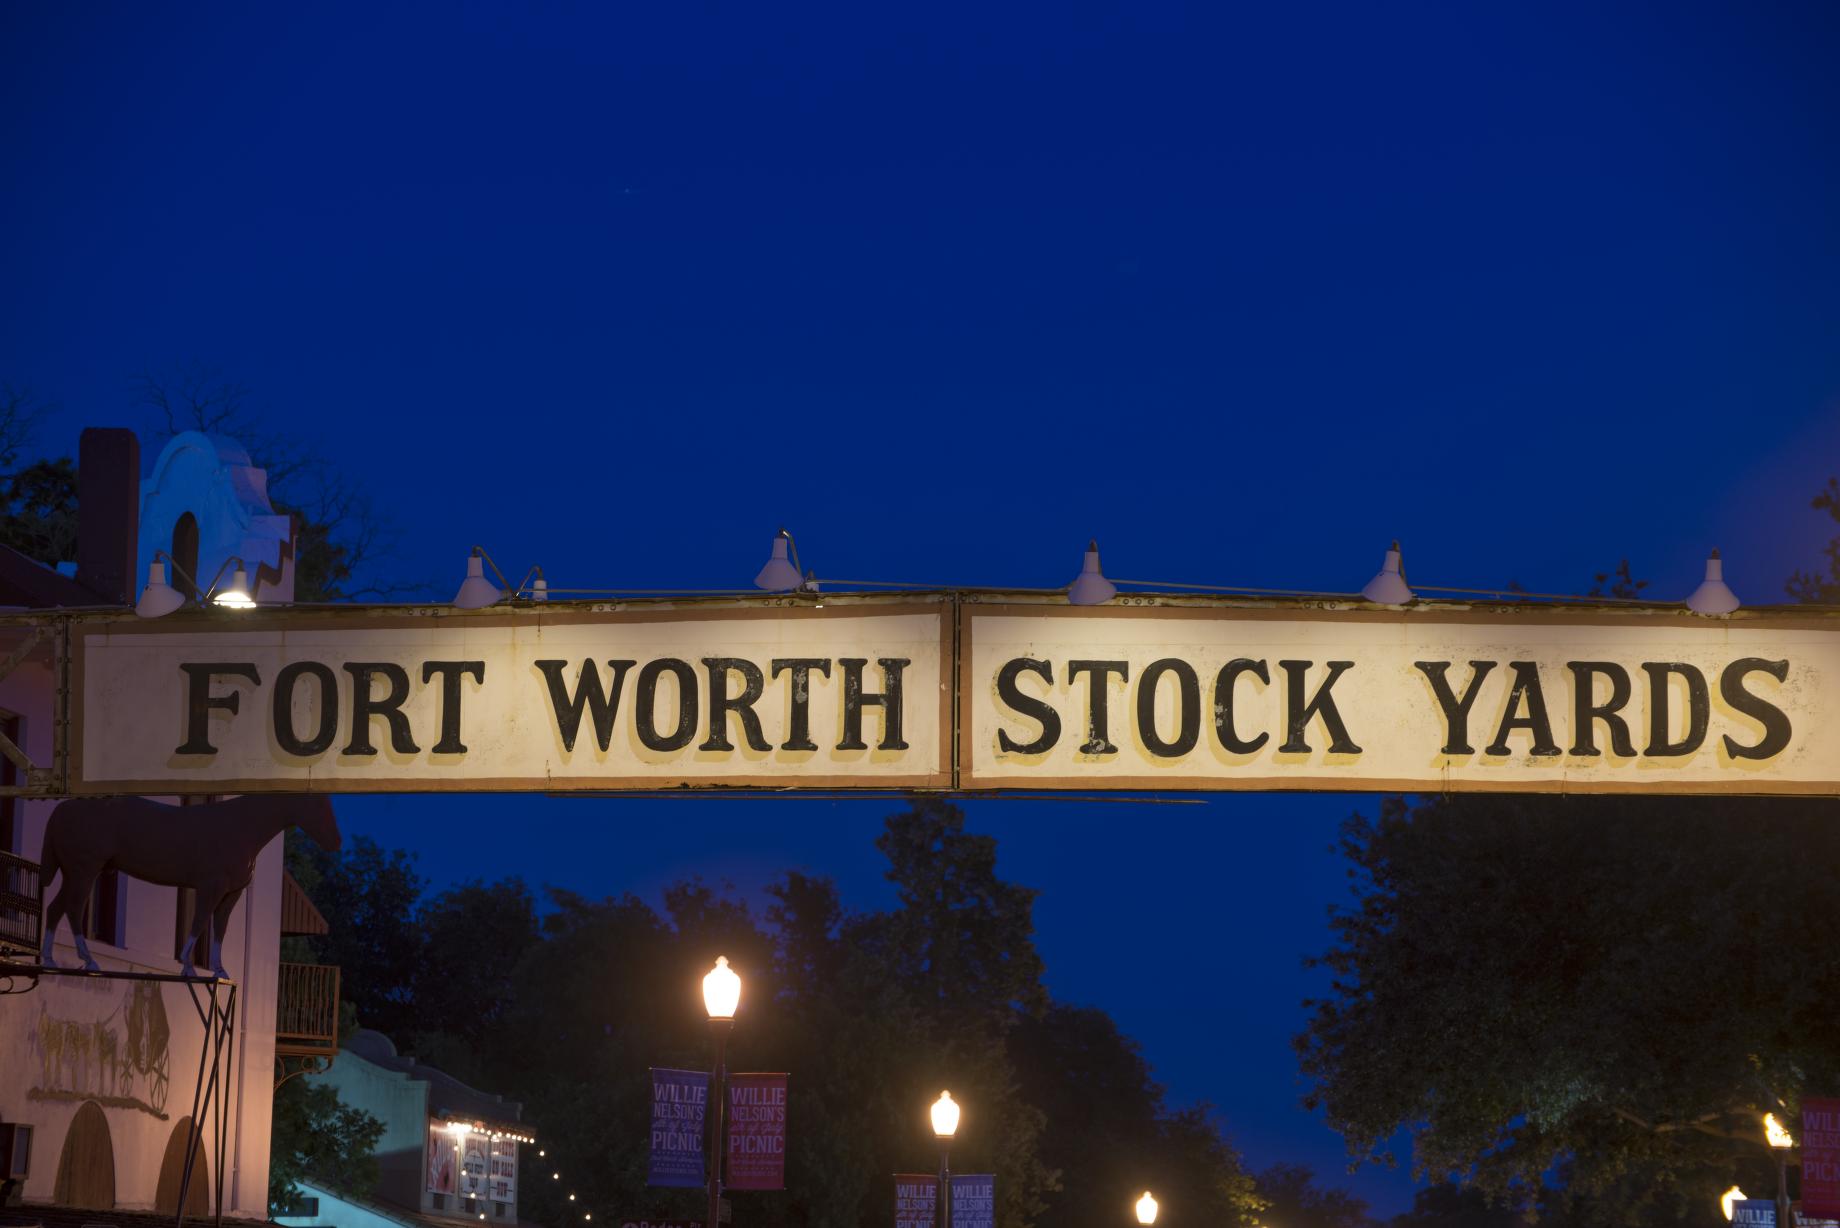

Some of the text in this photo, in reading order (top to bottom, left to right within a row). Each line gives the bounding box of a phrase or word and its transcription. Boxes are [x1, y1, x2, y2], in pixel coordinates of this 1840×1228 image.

[175, 656, 1793, 760] FORT WORTH STOCK YARDS
[653, 1083, 707, 1104] WILLIE
[731, 1088, 785, 1105] WILLIE
[653, 1102, 704, 1120] NELSON'S
[731, 1106, 785, 1121] NELSON'S
[1802, 1112, 1840, 1131] WIL
[651, 1131, 702, 1151] PICNIC
[729, 1135, 783, 1153] PICNIC
[896, 1184, 936, 1198] WILLIE
[953, 1184, 992, 1198] WILLIE
[1734, 1209, 1775, 1224] WILLIE
